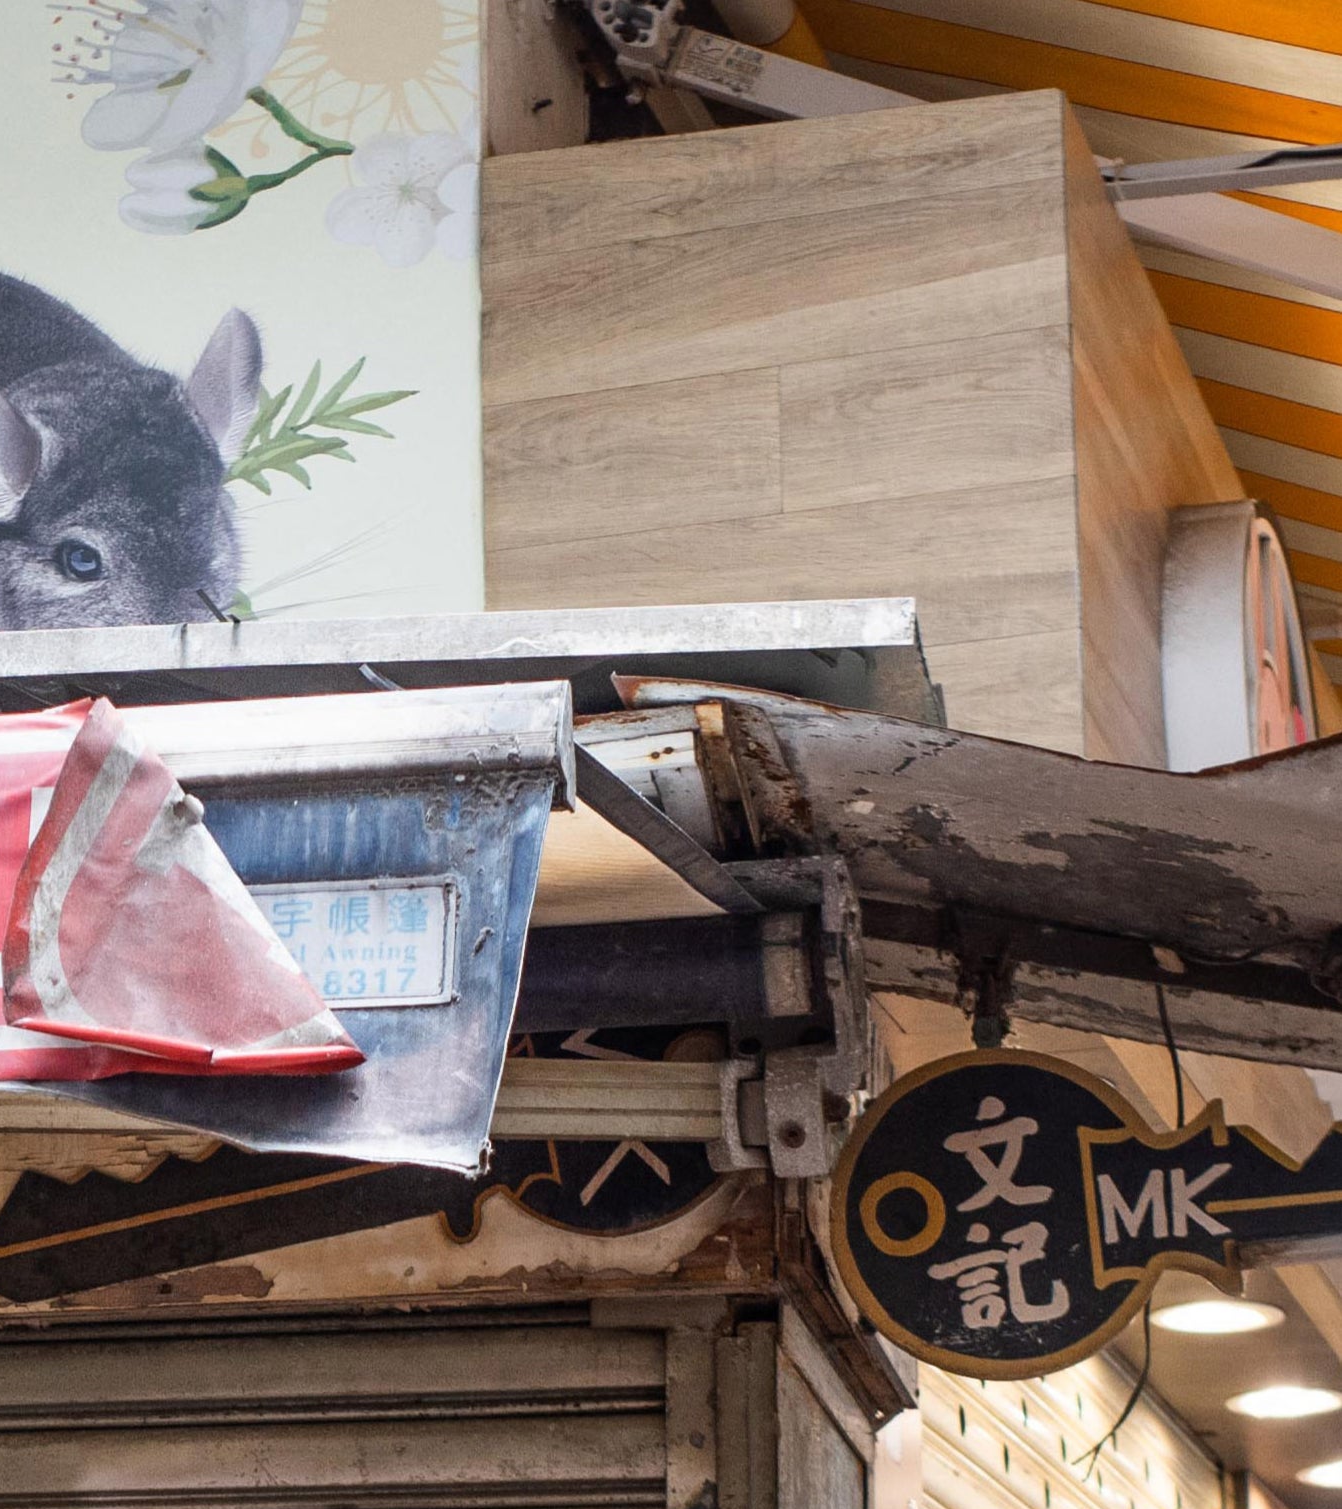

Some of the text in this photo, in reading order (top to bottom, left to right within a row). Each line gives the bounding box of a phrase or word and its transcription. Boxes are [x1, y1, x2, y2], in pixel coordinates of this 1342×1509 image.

[322, 941, 417, 963] Awning
[927, 1095, 1072, 1330] 文記
[1097, 1162, 1234, 1246] MK
